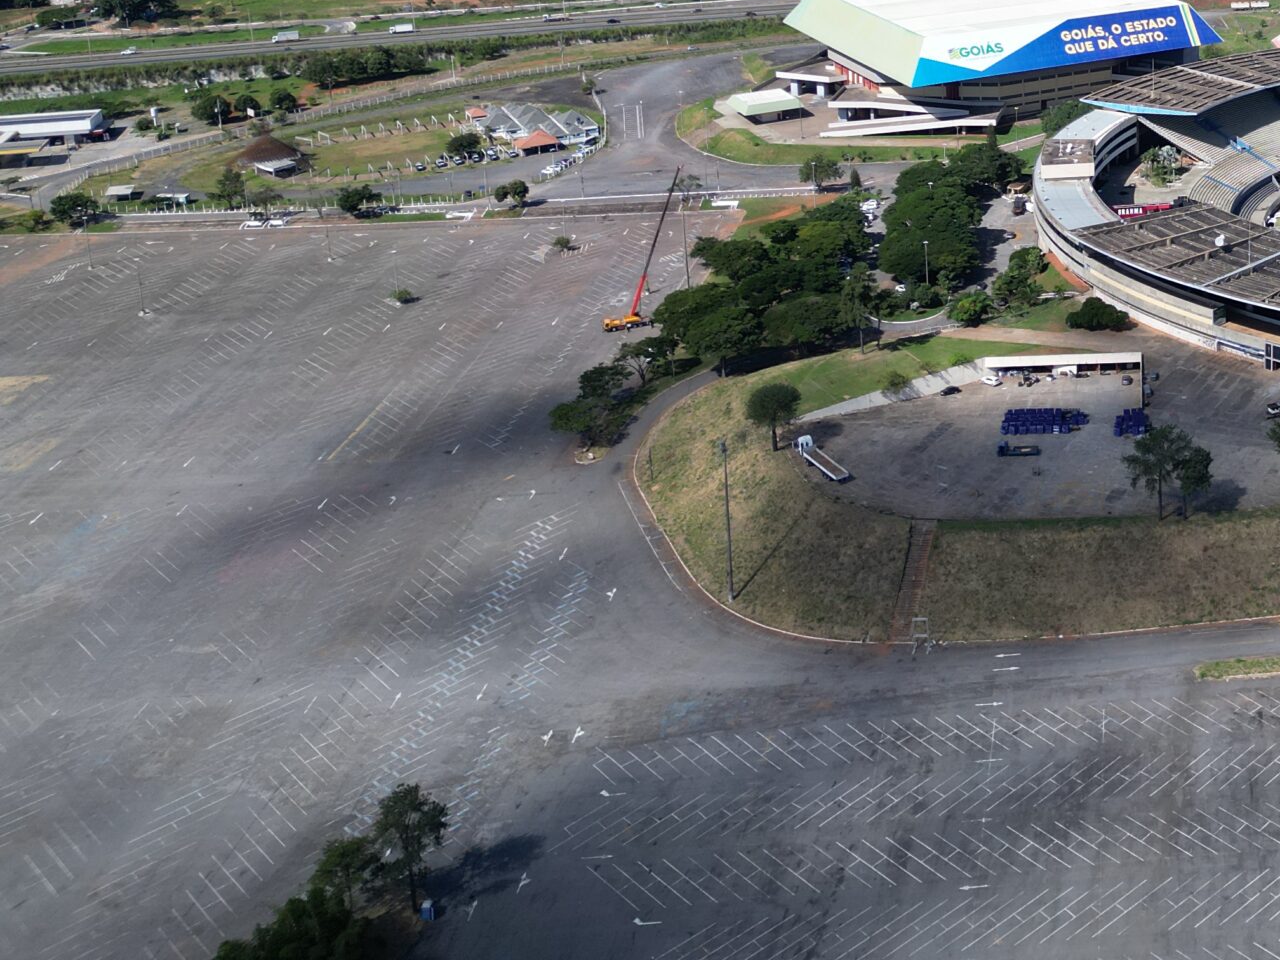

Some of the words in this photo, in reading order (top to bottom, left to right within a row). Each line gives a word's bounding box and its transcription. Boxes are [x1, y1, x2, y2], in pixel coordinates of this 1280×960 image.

[1060, 25, 1109, 41] GOIÁS,
[1111, 24, 1122, 35] O
[1125, 16, 1177, 32] ESTADO
[959, 41, 1004, 57] GOIÁS
[1064, 41, 1094, 55] QUE
[1098, 35, 1118, 50] DÁ
[1120, 31, 1168, 46] CERTO.
